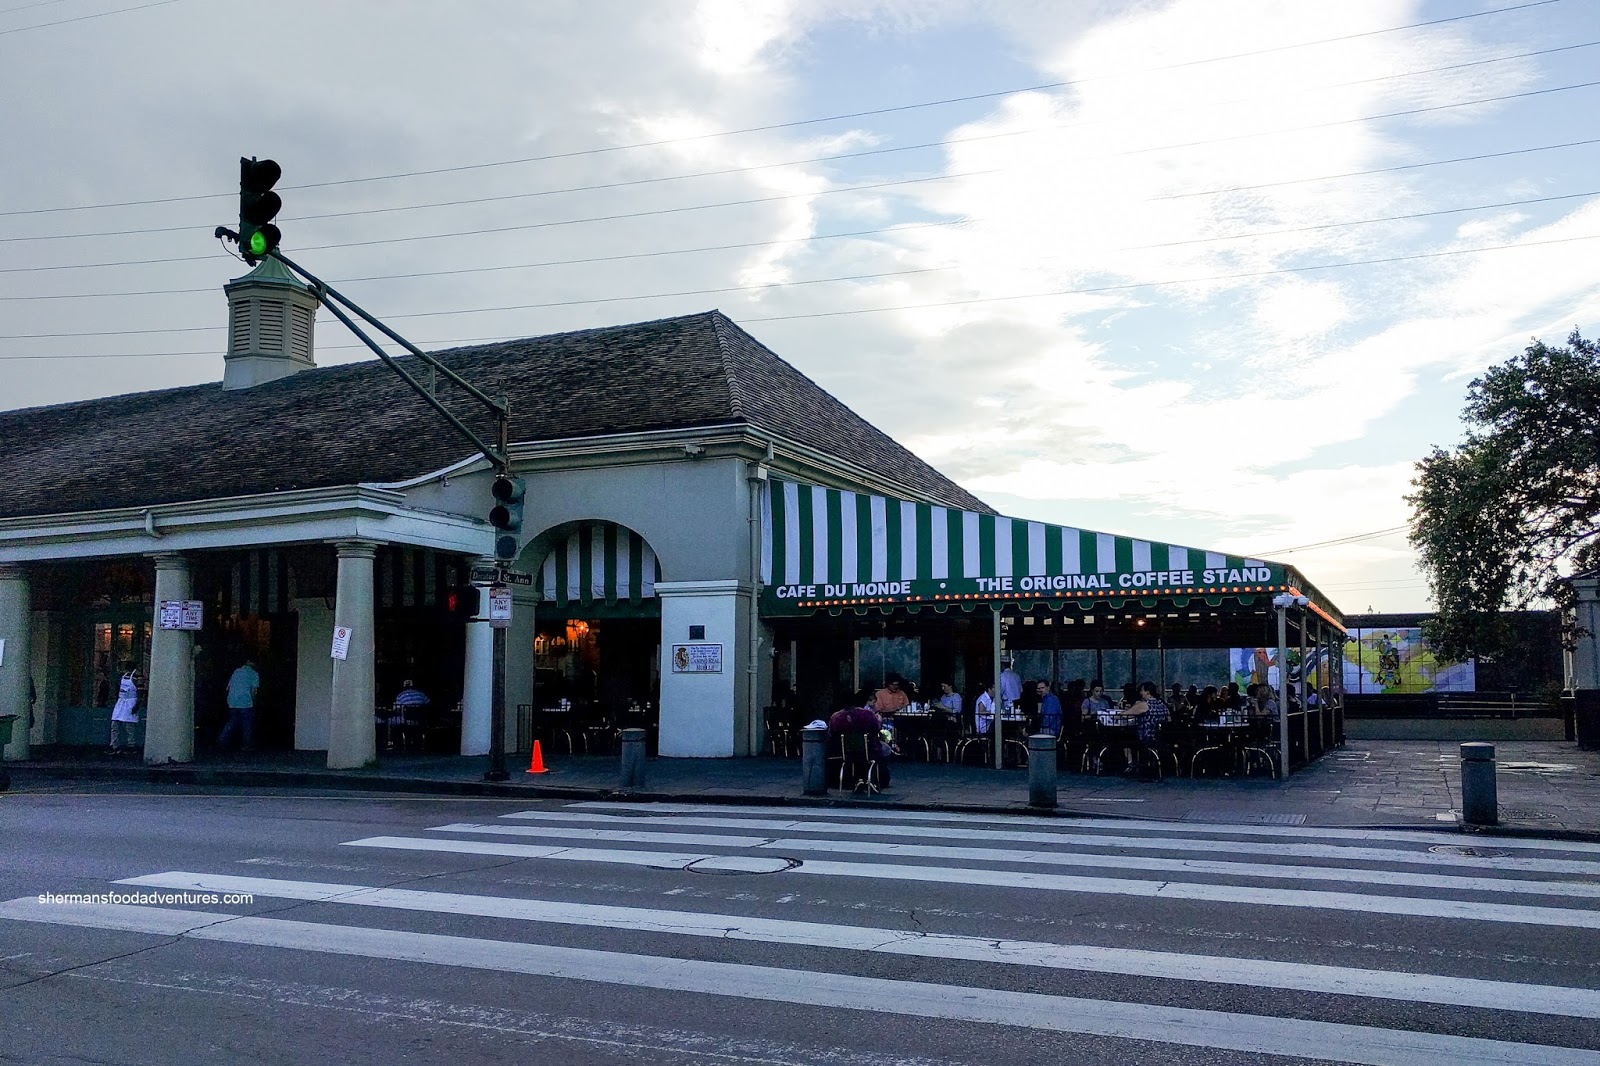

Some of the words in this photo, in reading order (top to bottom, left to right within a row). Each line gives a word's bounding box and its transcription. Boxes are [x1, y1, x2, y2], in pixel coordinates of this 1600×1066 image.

[515, 575, 530, 584] Ann
[776, 585, 816, 598] CAFE
[824, 584, 847, 597] DU
[852, 581, 911, 596] MONDE
[975, 577, 1013, 591] THE
[1020, 574, 1111, 590] ORIGINAL
[1118, 570, 1194, 587] COFFEE
[1202, 567, 1272, 584] STAND
